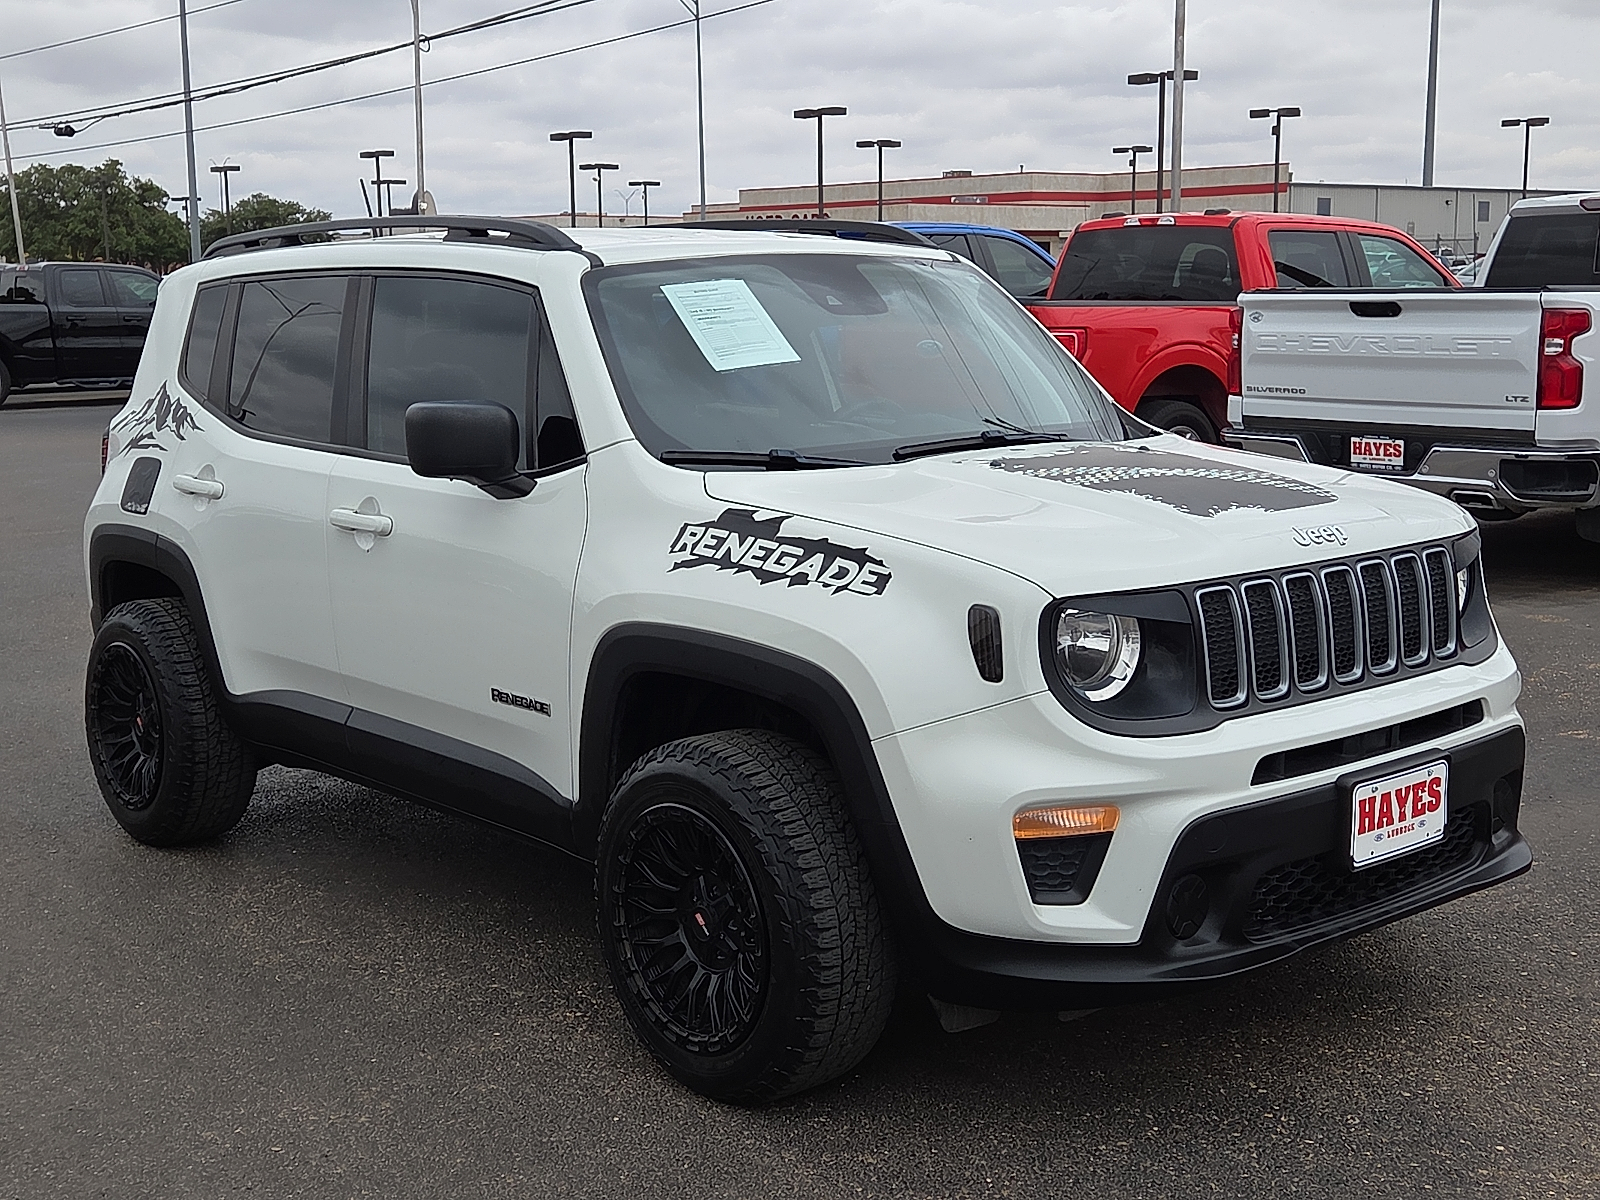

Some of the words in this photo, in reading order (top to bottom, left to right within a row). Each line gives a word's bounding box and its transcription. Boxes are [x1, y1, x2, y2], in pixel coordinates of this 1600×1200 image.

[1255, 334, 1513, 356] CHEVROLET
[1245, 385, 1307, 395] SILVERADO
[1505, 395, 1530, 404] LTZ
[1352, 441, 1402, 458] HAYES
[1291, 525, 1349, 547] Jeep
[671, 525, 890, 595] RENEGADE
[490, 687, 552, 717] RENEGADE
[1357, 776, 1442, 836] HAYES
